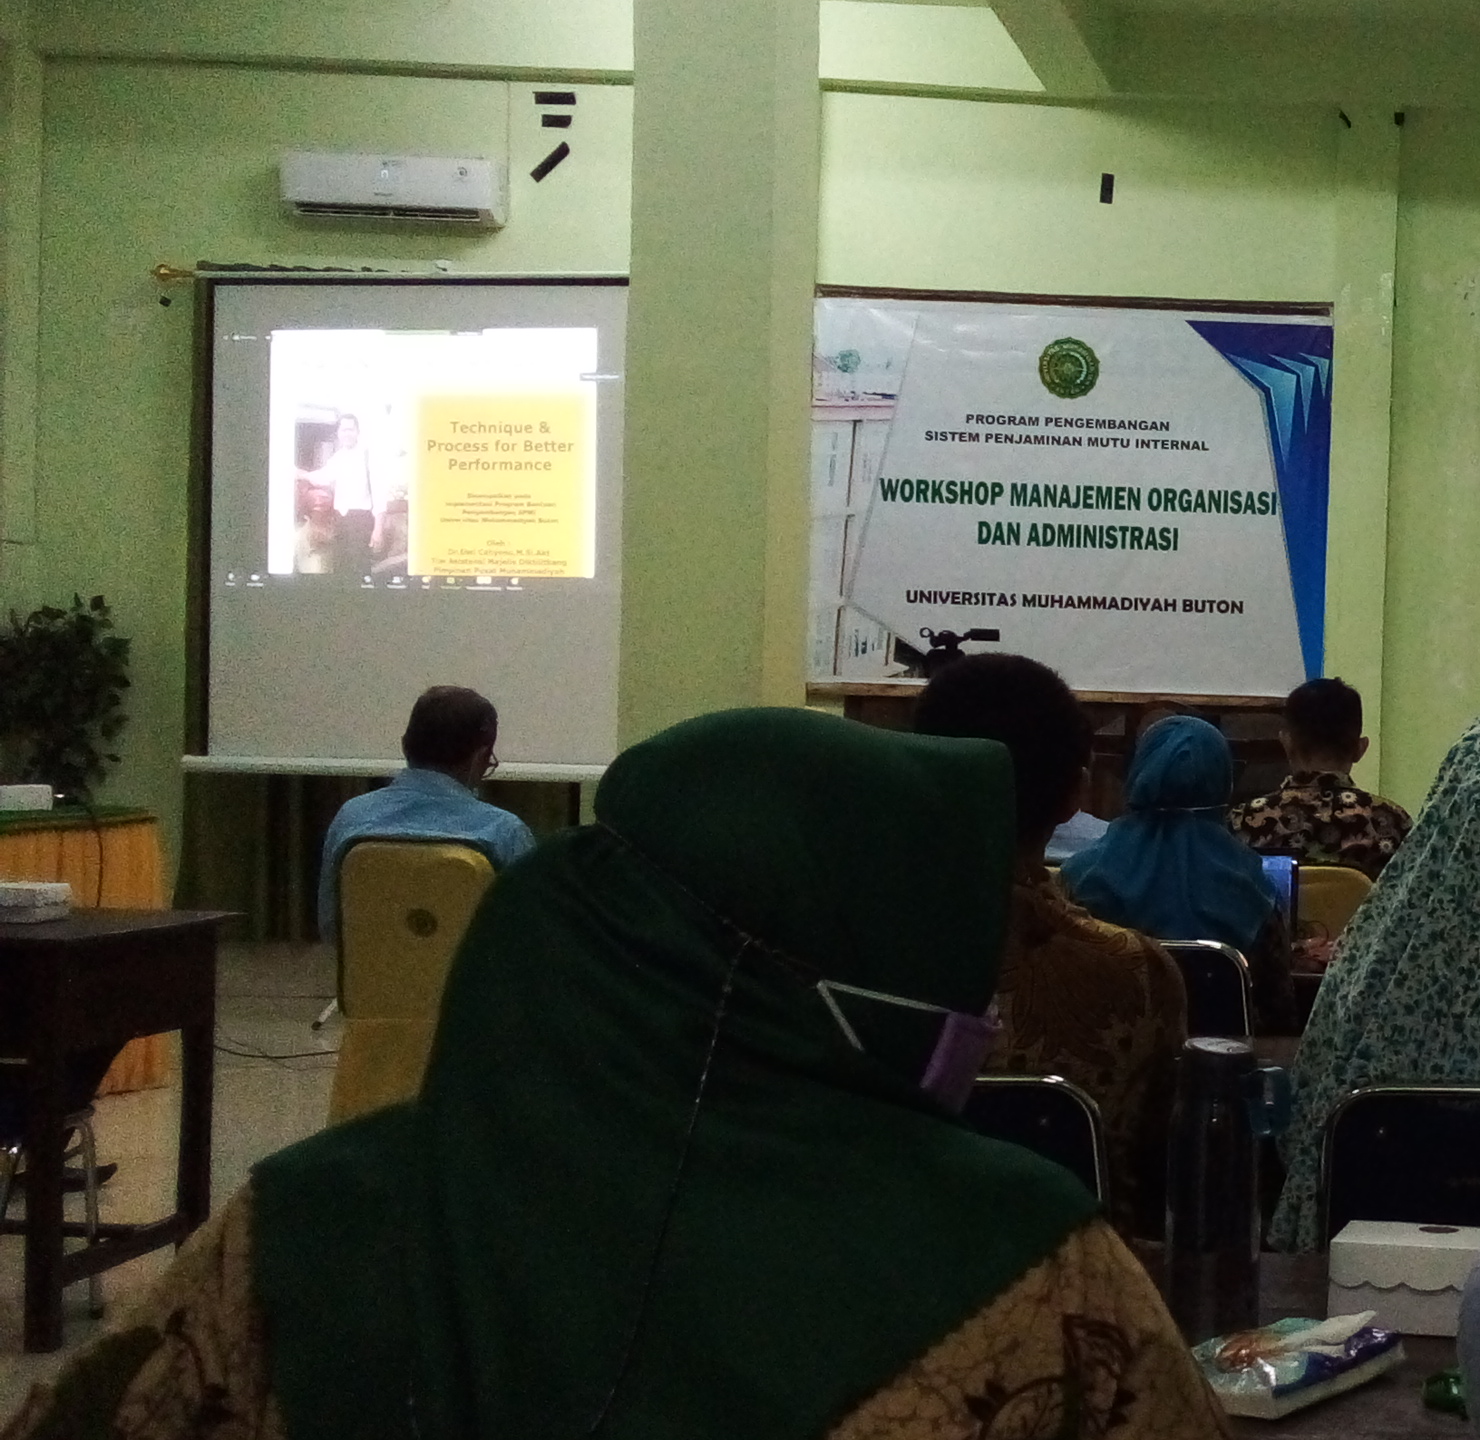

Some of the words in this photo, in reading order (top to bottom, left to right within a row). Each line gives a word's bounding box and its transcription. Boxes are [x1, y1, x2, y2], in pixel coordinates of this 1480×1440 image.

[450, 421, 533, 436] Technique
[539, 421, 551, 434] &
[965, 414, 1040, 427] PROGRAM
[1045, 416, 1170, 431] PENGEMBANGAN
[427, 440, 489, 452] Process
[495, 440, 518, 452] for
[523, 440, 575, 452] Better
[924, 430, 980, 443] SISTEM
[985, 433, 1082, 447] PENJAMINAN
[1087, 436, 1130, 448] MUTU
[1135, 439, 1210, 451] INTERNAL
[449, 458, 552, 471] Performance
[879, 478, 1004, 506] WORKSHOP
[1010, 482, 1141, 511] MANAJEMEN
[1147, 488, 1277, 515] ORGANISASI
[977, 521, 1021, 546] DAN
[1026, 523, 1179, 550] ADMINISTRASI
[906, 589, 1017, 607] UNIVERSITAS
[1022, 593, 1177, 612] MUHAMMADIYAH
[1182, 600, 1244, 614] BUTON
